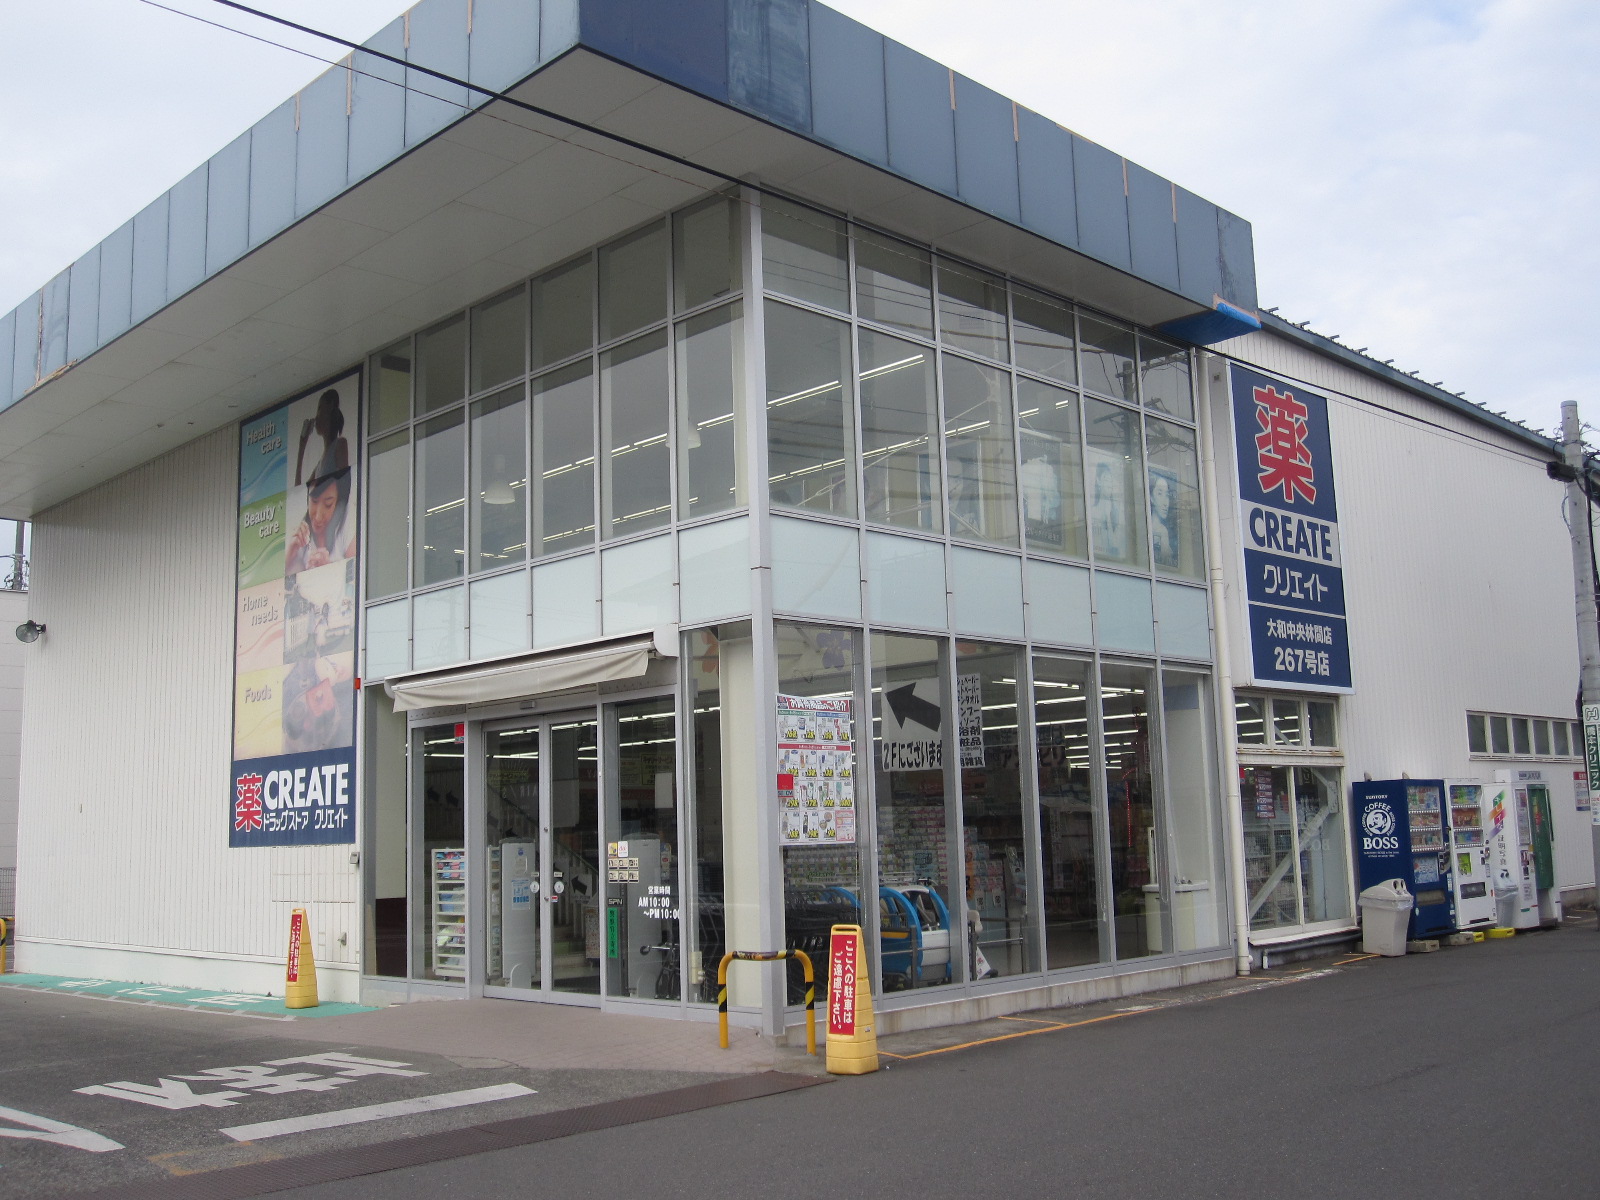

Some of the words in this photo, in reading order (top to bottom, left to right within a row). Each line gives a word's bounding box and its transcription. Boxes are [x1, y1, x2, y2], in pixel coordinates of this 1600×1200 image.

[246, 421, 275, 446] Health
[261, 437, 282, 455] care
[1253, 384, 1317, 505] 薬
[244, 505, 275, 528] Beauty
[259, 521, 280, 538] care
[1249, 507, 1332, 561] CREATE
[1263, 564, 1328, 602] クリエイト
[243, 595, 268, 612] Home
[251, 605, 279, 626] needs
[1266, 618, 1332, 645] 大和中央林間店
[1273, 646, 1330, 676] 267号店
[245, 685, 272, 703] Foods
[235, 773, 262, 832] 薬
[264, 764, 348, 810] CREATE
[1365, 802, 1391, 812] COFFEE
[263, 810, 308, 831] ドラッグストア
[314, 808, 348, 829] クリエイト
[1362, 837, 1399, 850] BOSS
[832, 951, 844, 1029] ご遠慮下さい。
[843, 940, 854, 1023] ここへの駐車は
[72, 1052, 431, 1110] 止まれ
